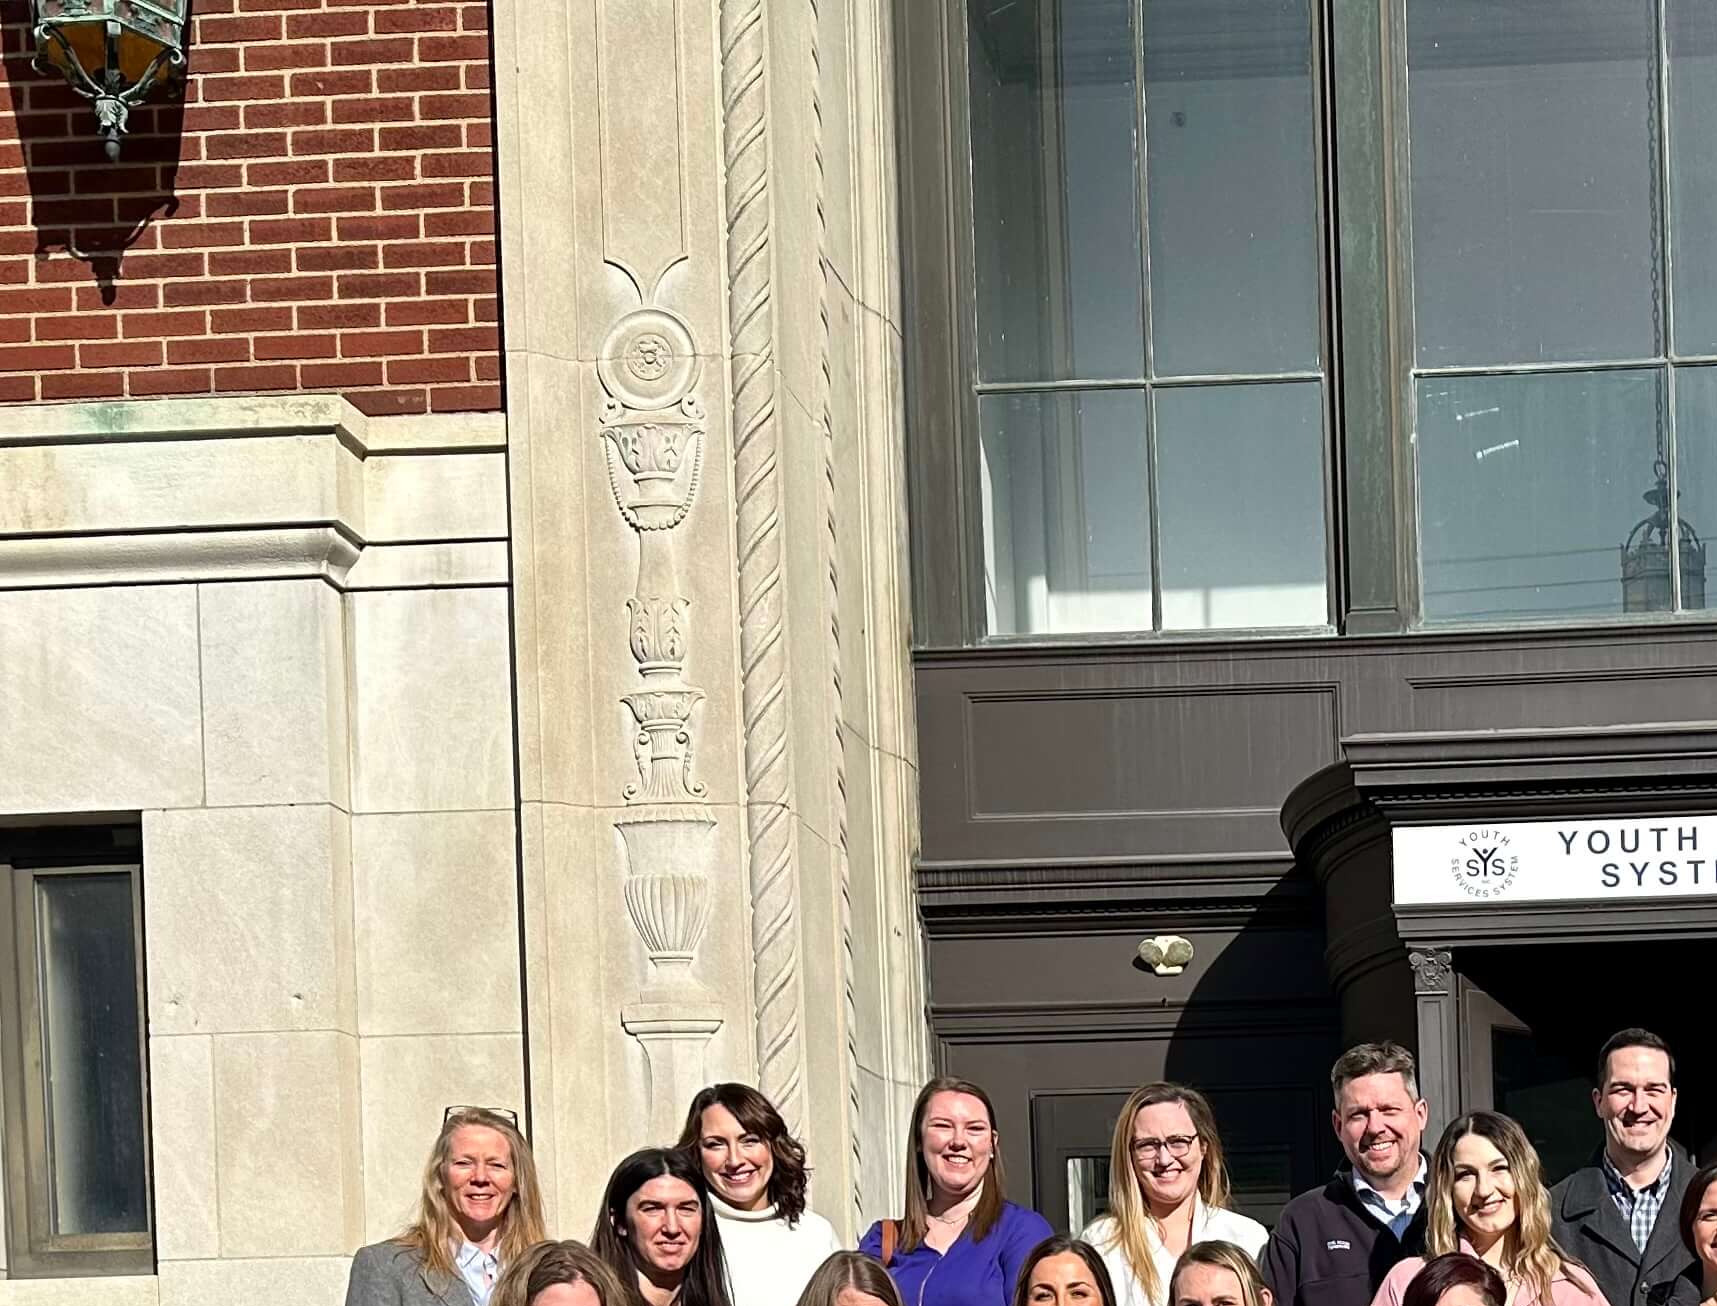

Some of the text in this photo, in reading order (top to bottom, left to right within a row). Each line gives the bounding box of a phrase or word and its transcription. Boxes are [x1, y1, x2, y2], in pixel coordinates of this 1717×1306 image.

[1458, 828, 1511, 847] YOUTH
[1557, 827, 1698, 855] YOUTH
[1451, 855, 1519, 898] SERVICES SYSTEM
